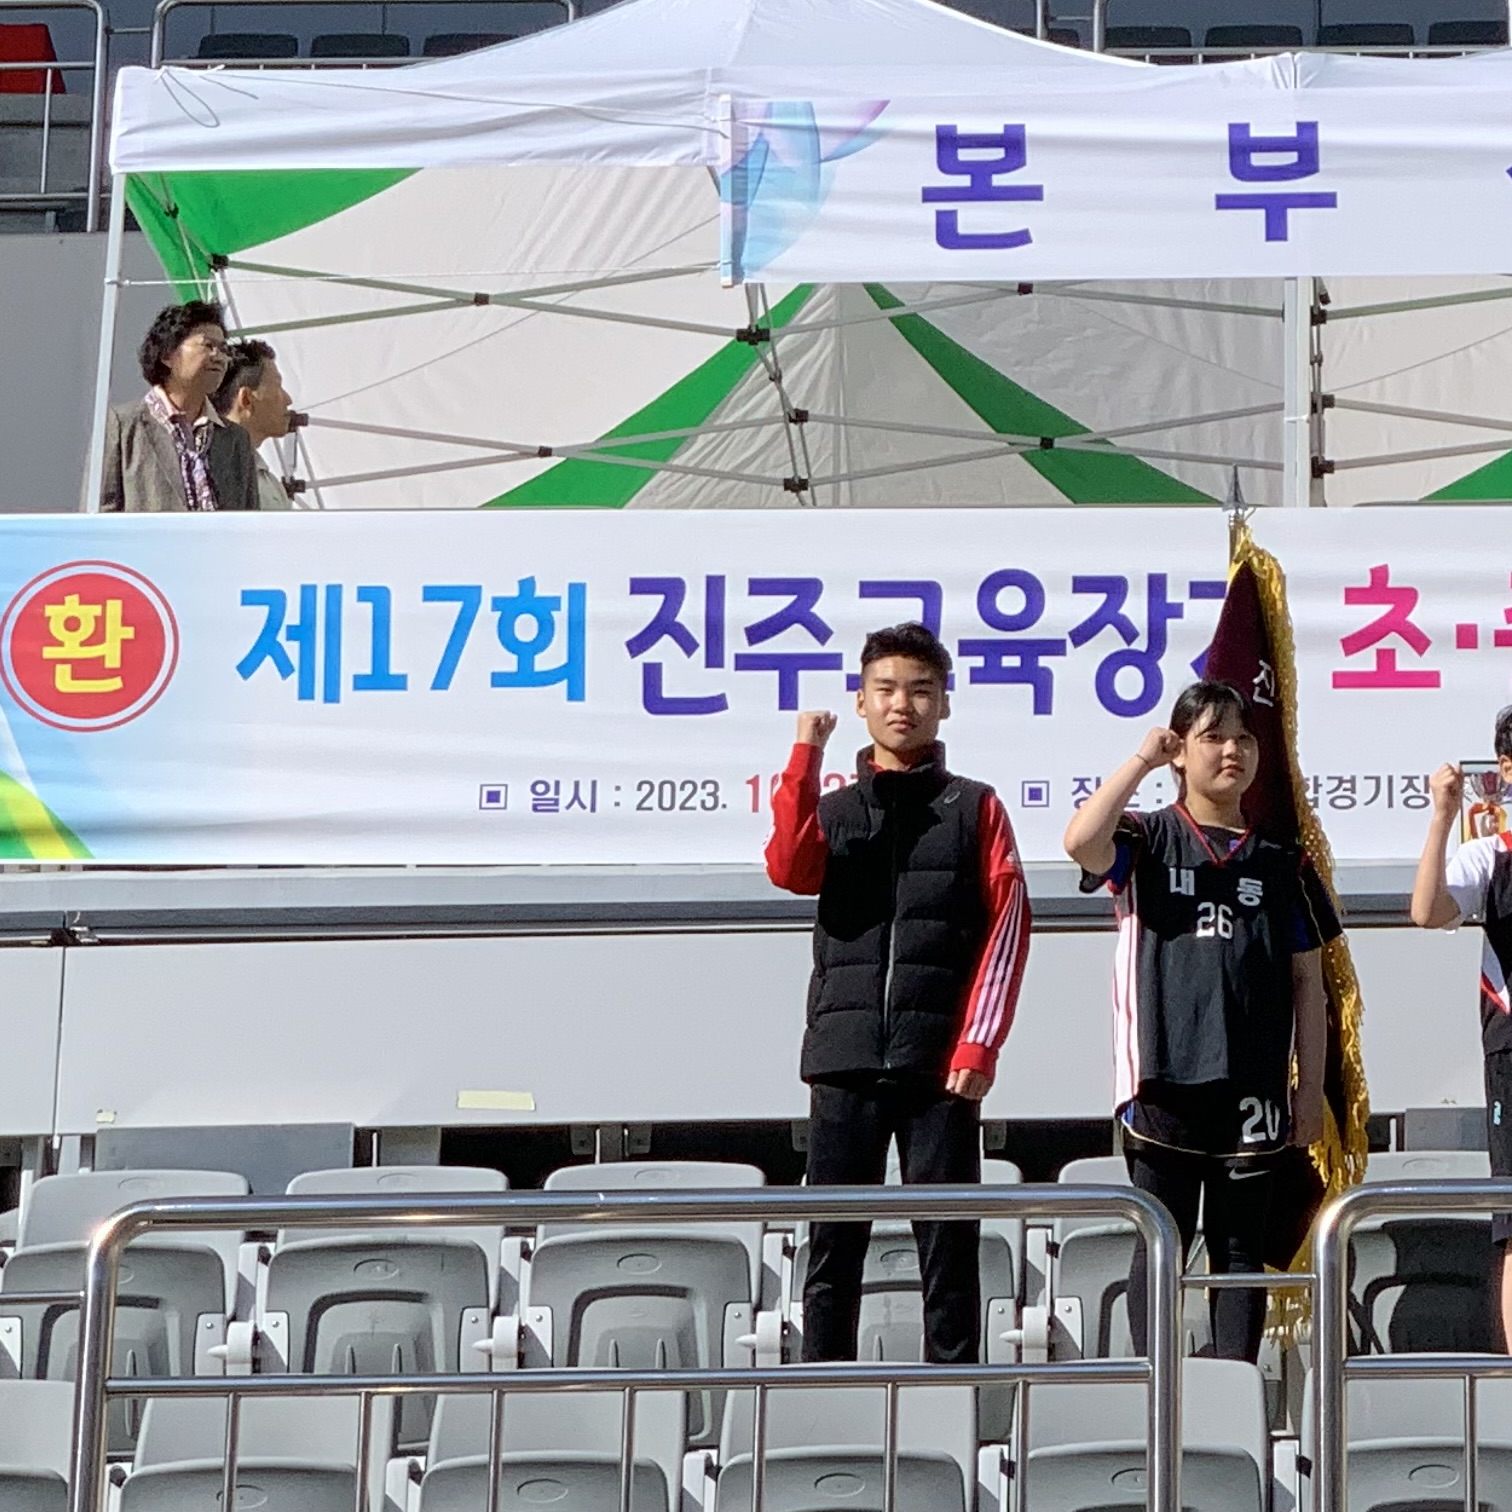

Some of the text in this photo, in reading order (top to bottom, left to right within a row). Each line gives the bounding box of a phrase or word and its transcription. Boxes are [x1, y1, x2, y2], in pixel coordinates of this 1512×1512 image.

[42, 594, 135, 693] 환
[235, 575, 588, 704] 제17회
[529, 779, 599, 814] 일시
[635, 780, 728, 812] 2023.
[1196, 901, 1233, 940] 26
